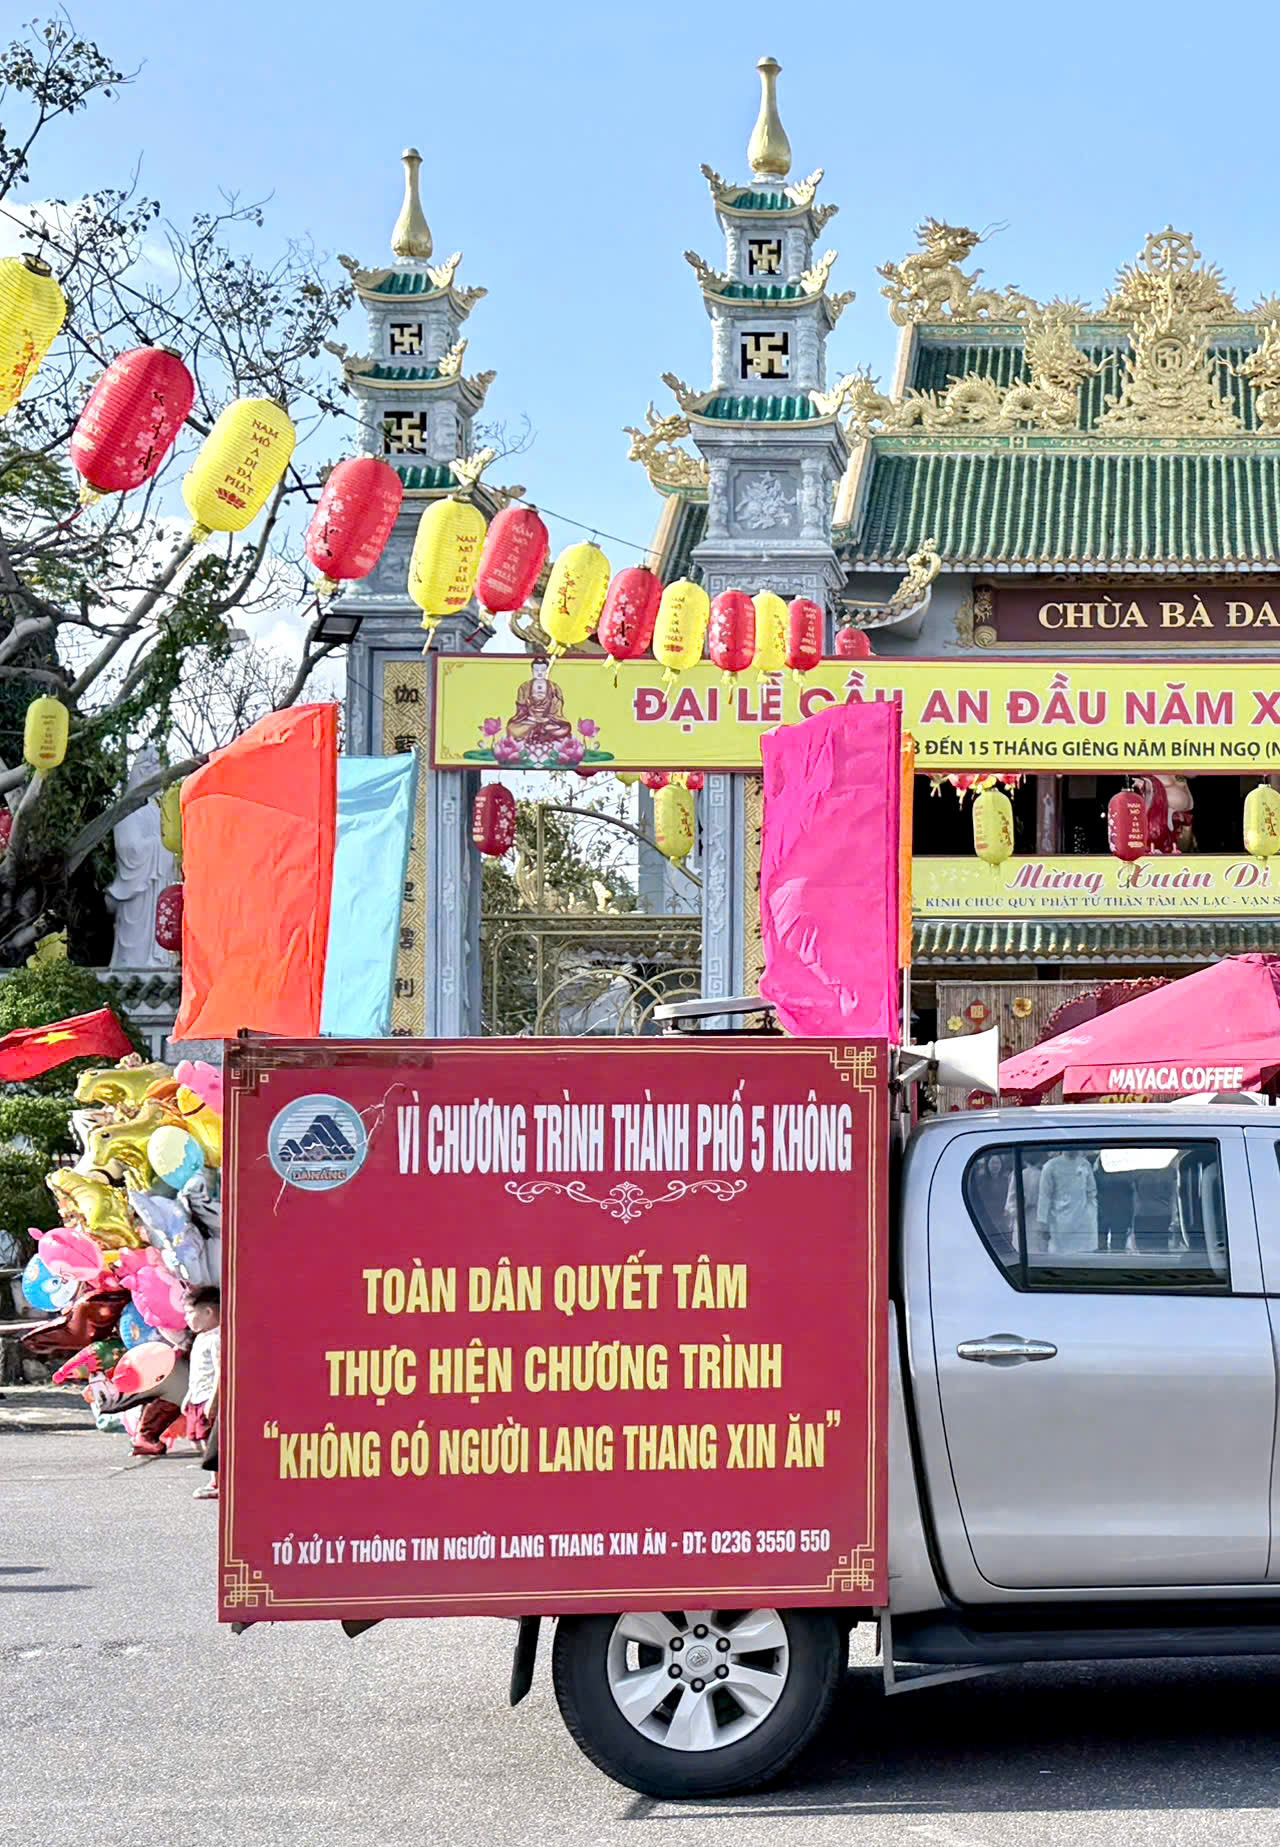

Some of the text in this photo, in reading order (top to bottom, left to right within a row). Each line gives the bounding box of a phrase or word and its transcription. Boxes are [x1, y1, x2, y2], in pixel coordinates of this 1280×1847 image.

[250, 432, 270, 447] MÔ
[252, 419, 280, 439] NAM
[244, 457, 258, 470] DI
[251, 448, 259, 457] A
[456, 535, 477, 543] NAM
[1038, 594, 1280, 629] CHÙA BÀ ĐA
[634, 687, 718, 732] ĐẠI
[738, 671, 782, 721] LỄ
[920, 690, 989, 723] AN
[1006, 672, 1106, 725] ĐẦU
[1125, 682, 1233, 725] NĂM
[925, 735, 964, 755] ĐẾN
[970, 741, 989, 755] 15
[993, 738, 1058, 756] THÁNG
[1068, 738, 1119, 756] GIÊNG
[1123, 738, 1166, 756] NĂM
[1174, 738, 1215, 756] BÍNH
[1220, 741, 1261, 761] NGỌ
[1005, 863, 1104, 894] Mừng
[1117, 862, 1213, 889] Xuân
[1224, 862, 1270, 888] Di
[925, 896, 960, 907] KÍNH
[965, 896, 1003, 907] CHÚC
[1008, 896, 1035, 908] QUÝ
[1041, 896, 1079, 908] PHẬT
[1082, 895, 1100, 907] TỬ
[1104, 896, 1144, 907] THÂN
[1147, 896, 1177, 906] TÂM
[1181, 896, 1199, 906] AN
[1203, 896, 1230, 906] LẠC
[1241, 896, 1269, 907] VẠN
[1108, 1066, 1244, 1090] MAYACA COFFEE
[397, 1080, 852, 1174] VÌ CHƯƠNG TRÌNH THÀNH PHỐ 5 KHÔNG
[363, 1250, 747, 1316] TOÀN DÂN QUYẾT TÂM
[326, 1334, 783, 1405] THỰC HIỆN CHƯƠNG TRÌNH
[391, 1420, 430, 1476] CÓ
[440, 1416, 529, 1475] NGƯỜI
[539, 1425, 614, 1472] LANG
[623, 1424, 718, 1470] THANG
[727, 1424, 777, 1468] XIN
[272, 1532, 294, 1565] TỔ
[297, 1533, 321, 1564] XỬ
[326, 1532, 346, 1563] LÝ
[350, 1534, 407, 1562] THÔNG
[411, 1537, 439, 1561] TIN
[444, 1530, 496, 1560] NGƯỜI
[501, 1535, 545, 1559] LANG
[549, 1533, 605, 1558] THANG
[609, 1533, 639, 1556] XIN
[643, 1528, 667, 1555] ĂN
[683, 1531, 707, 1555] ĐT:
[711, 1531, 752, 1554] 0236
[756, 1530, 796, 1553] 3550
[801, 1529, 831, 1553] 550
